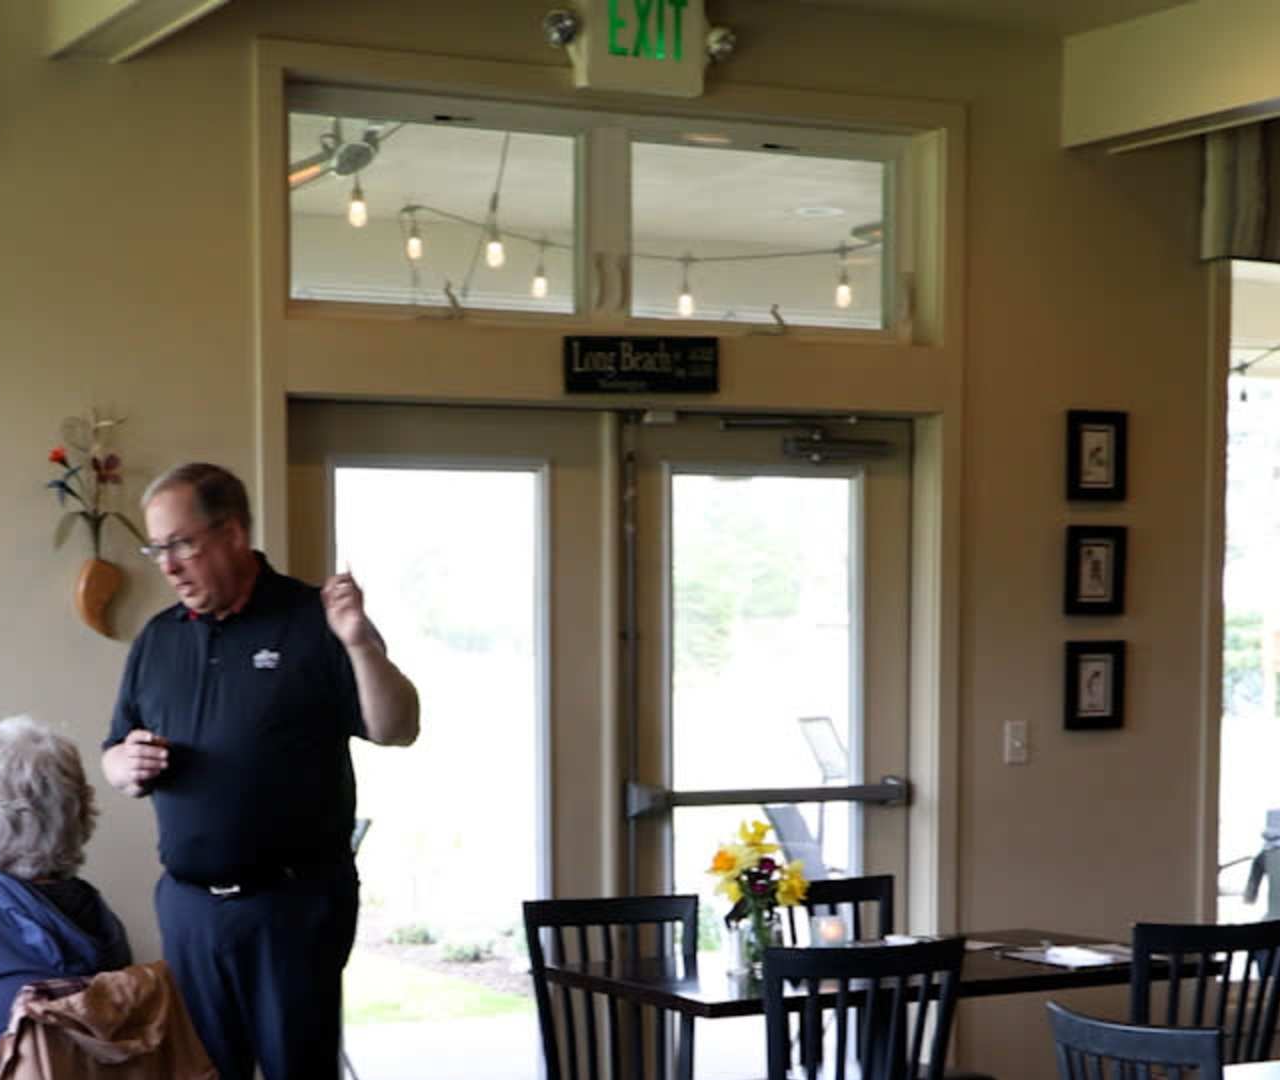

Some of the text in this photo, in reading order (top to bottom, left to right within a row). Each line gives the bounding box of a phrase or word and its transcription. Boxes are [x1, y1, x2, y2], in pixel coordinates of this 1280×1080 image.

[608, 0, 688, 60] EXIT
[571, 341, 618, 377] Long
[620, 341, 673, 373] Beach
